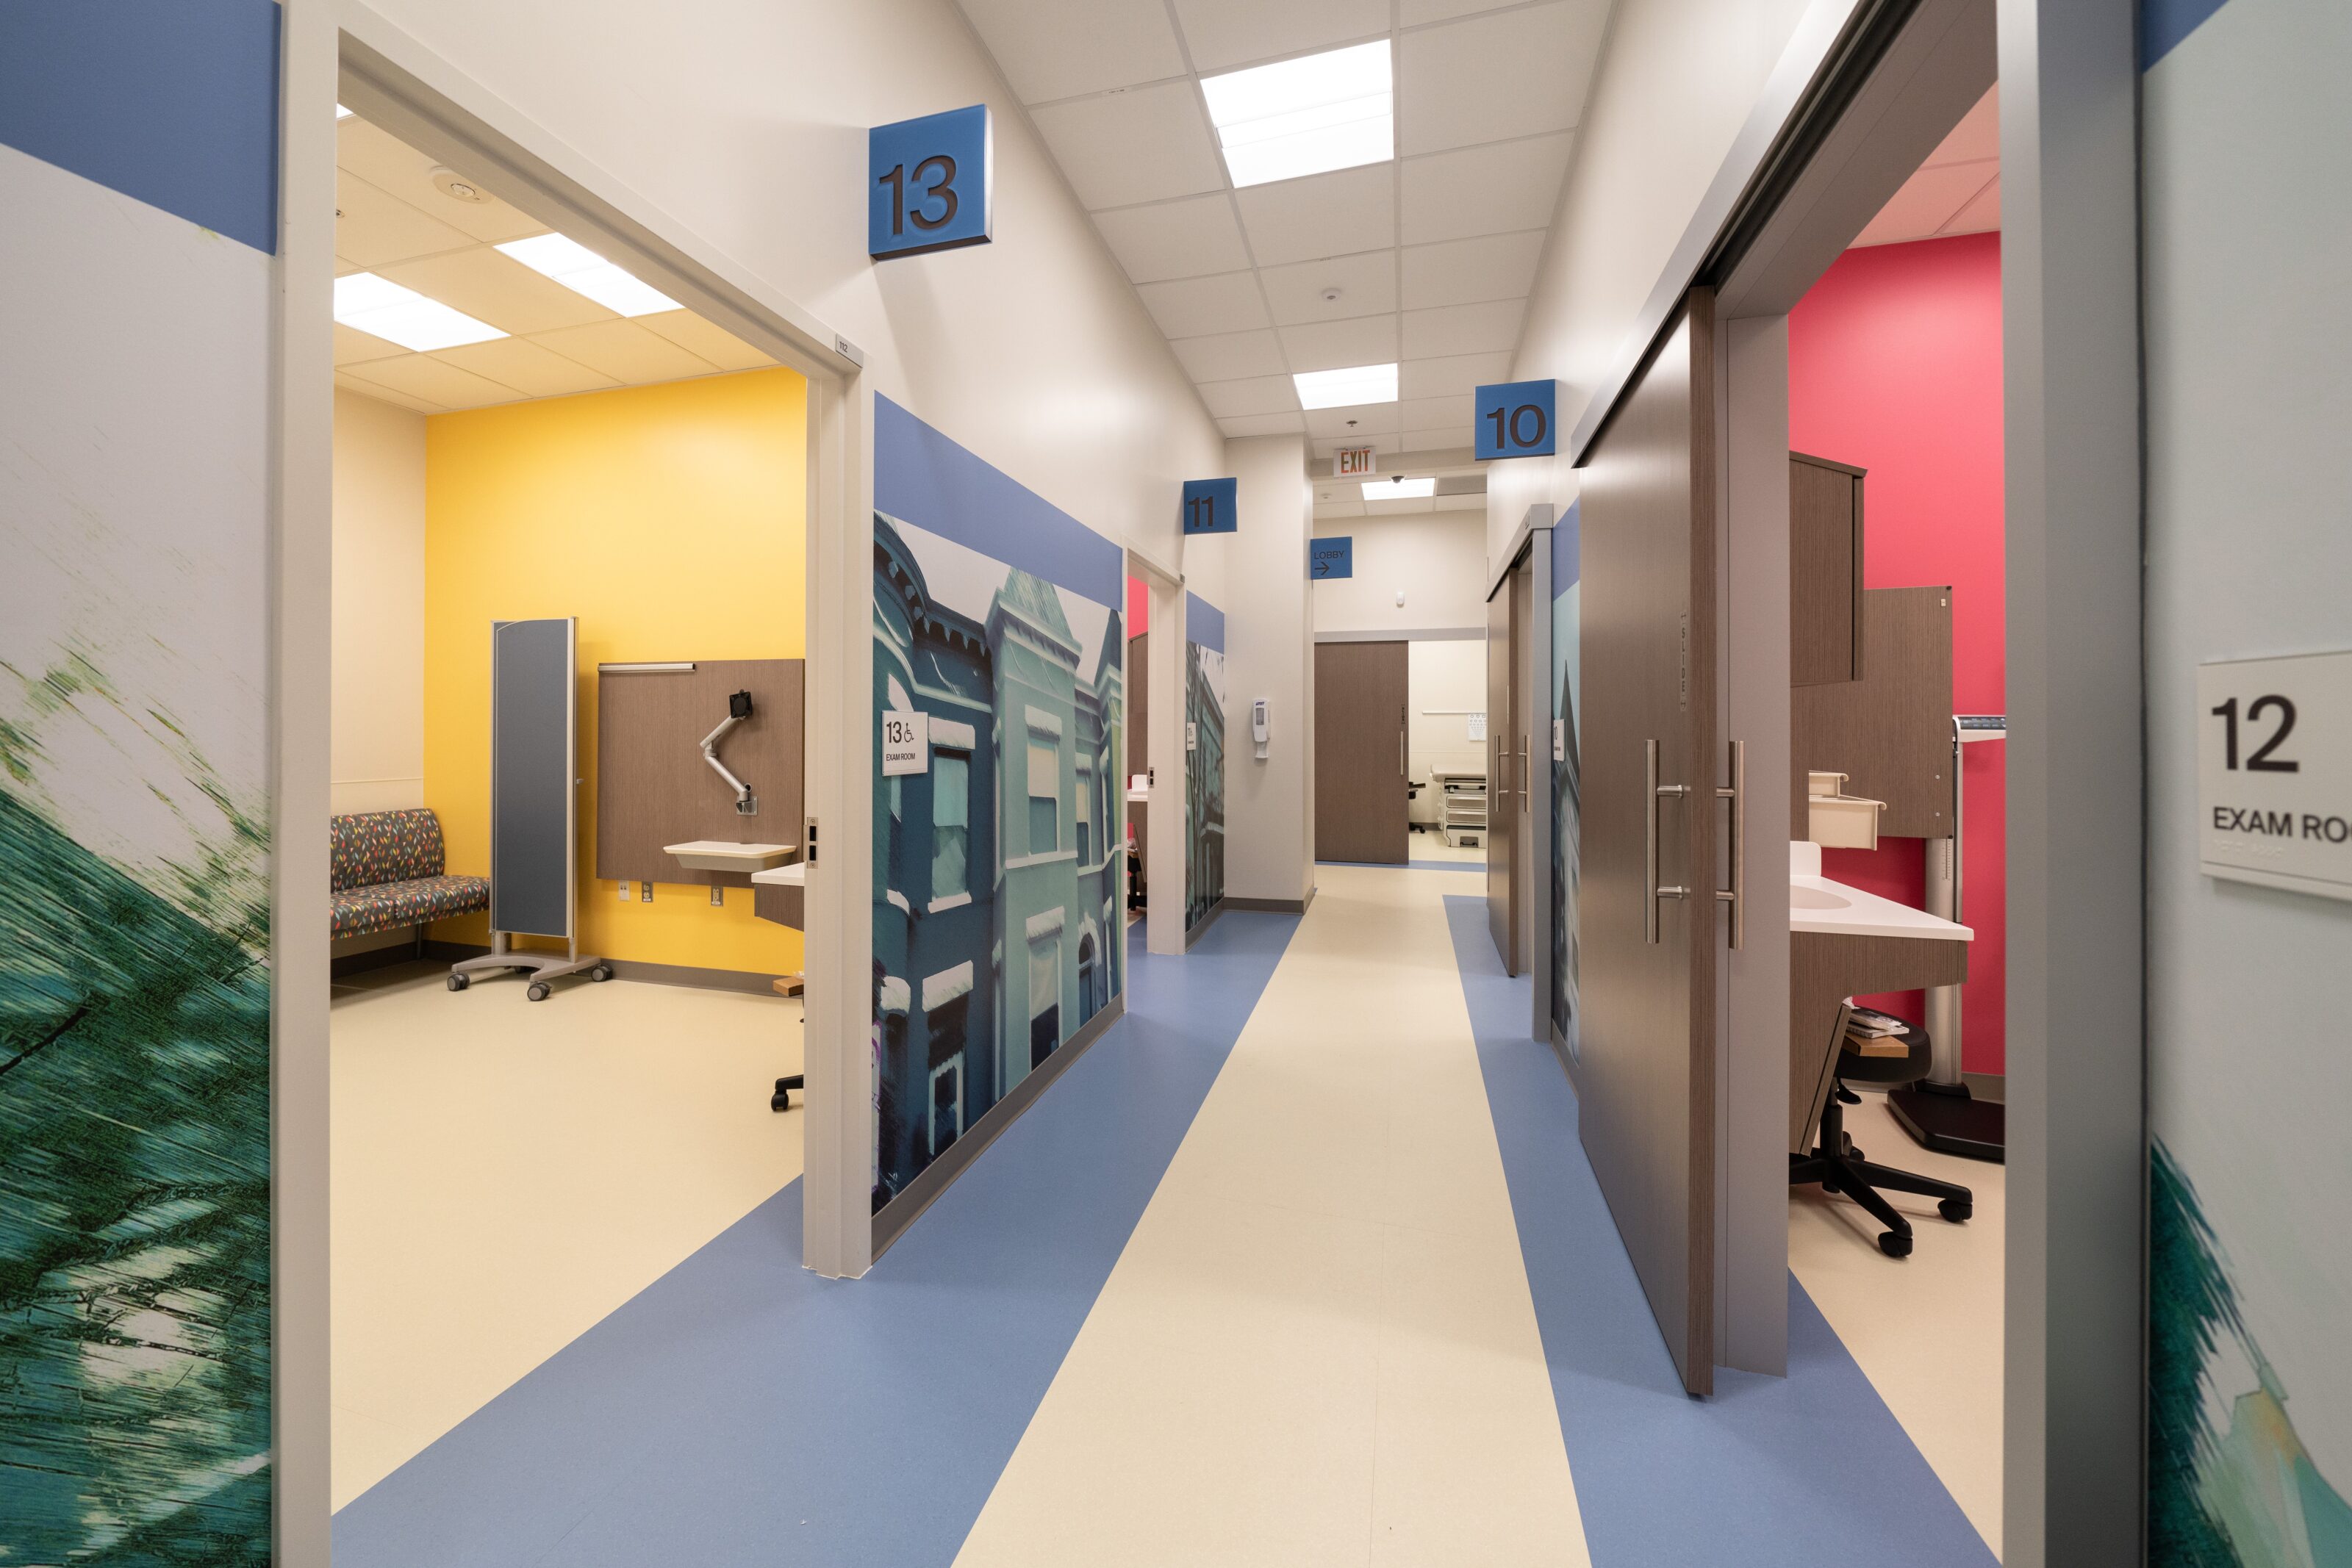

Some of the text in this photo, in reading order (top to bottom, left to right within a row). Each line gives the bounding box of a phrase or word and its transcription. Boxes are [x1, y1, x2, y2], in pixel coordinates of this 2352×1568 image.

[879, 155, 958, 235] 13
[1487, 404, 1546, 449] 10
[1341, 450, 1371, 474] EXIT
[1188, 496, 1213, 528] 11
[1314, 550, 1345, 560] LOBBY
[886, 721, 902, 744] 13
[2212, 694, 2299, 773] 12
[886, 752, 916, 761] EXAM ROOM
[2214, 807, 2292, 838] EXAM
